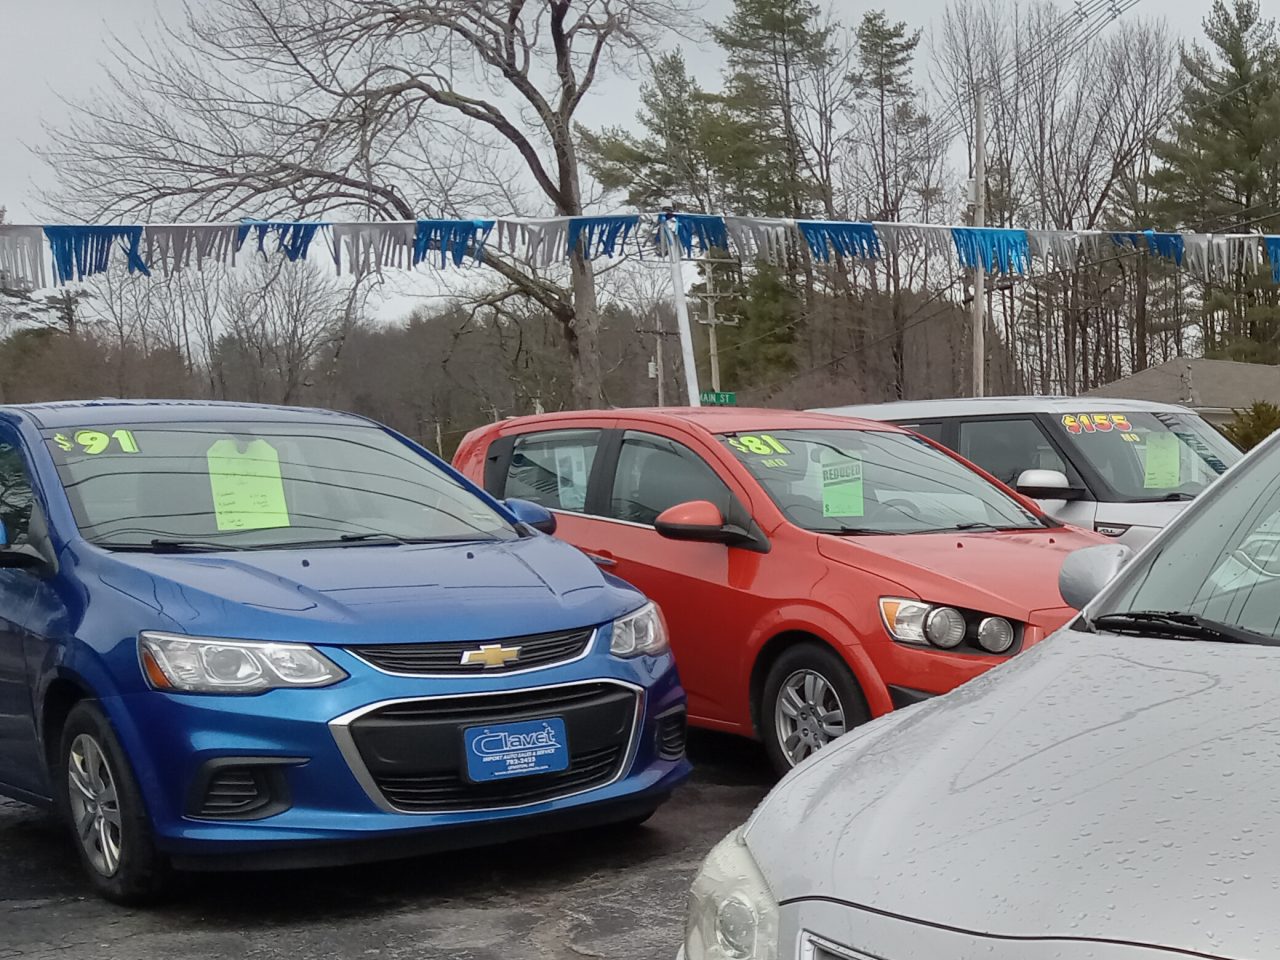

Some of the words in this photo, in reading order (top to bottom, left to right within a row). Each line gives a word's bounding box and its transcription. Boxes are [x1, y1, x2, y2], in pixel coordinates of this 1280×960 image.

[720, 394, 730, 403] ST
[1062, 414, 1132, 434] $155
[53, 429, 141, 455] $91
[727, 434, 792, 456] $81
[823, 463, 861, 482] REDUCED
[472, 727, 561, 756] Clavet
